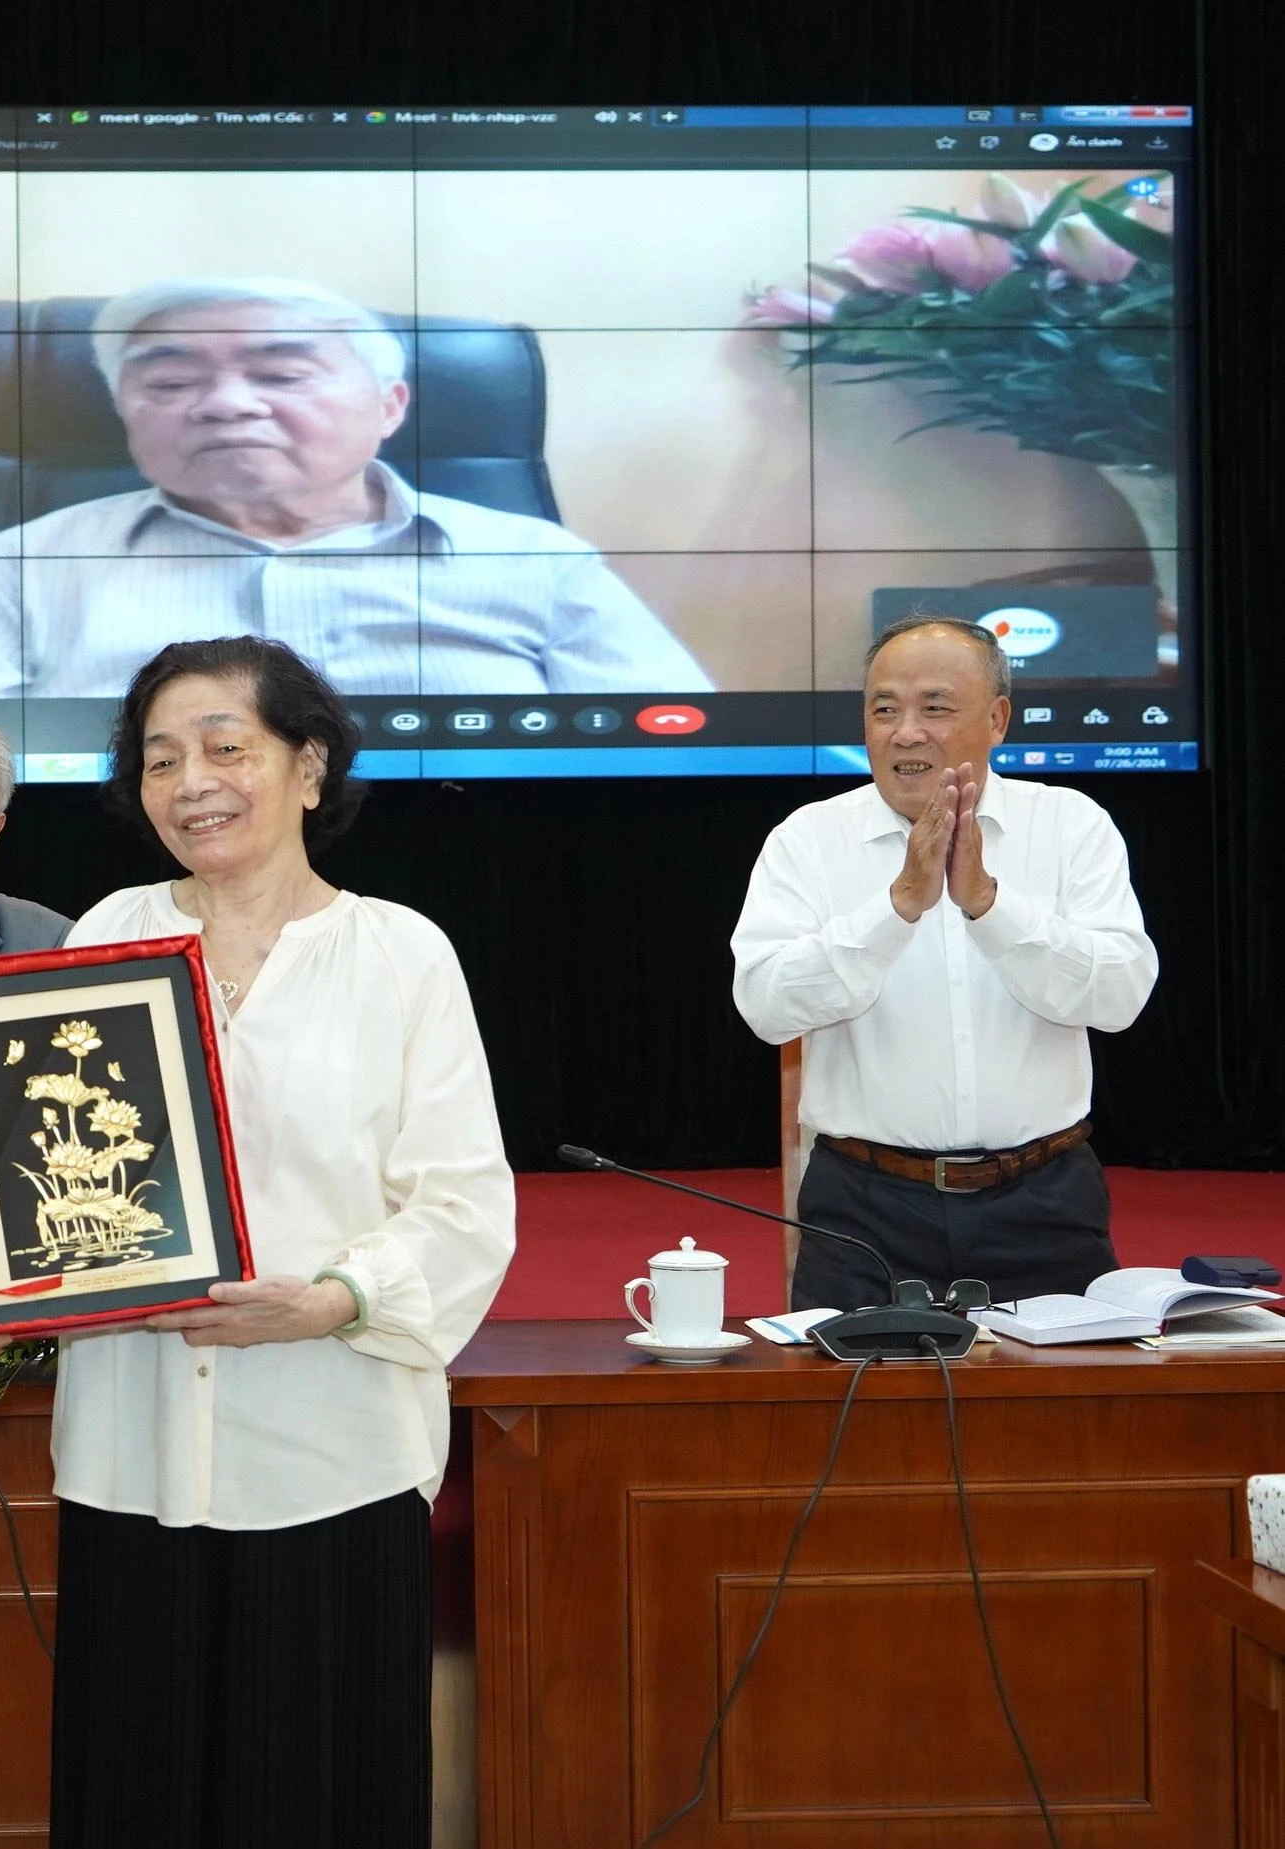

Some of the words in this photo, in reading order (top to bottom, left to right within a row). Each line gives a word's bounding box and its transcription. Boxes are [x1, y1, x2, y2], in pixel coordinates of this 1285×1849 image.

[100, 113, 140, 123] meet
[143, 113, 199, 125] google
[395, 112, 437, 123] Meet
